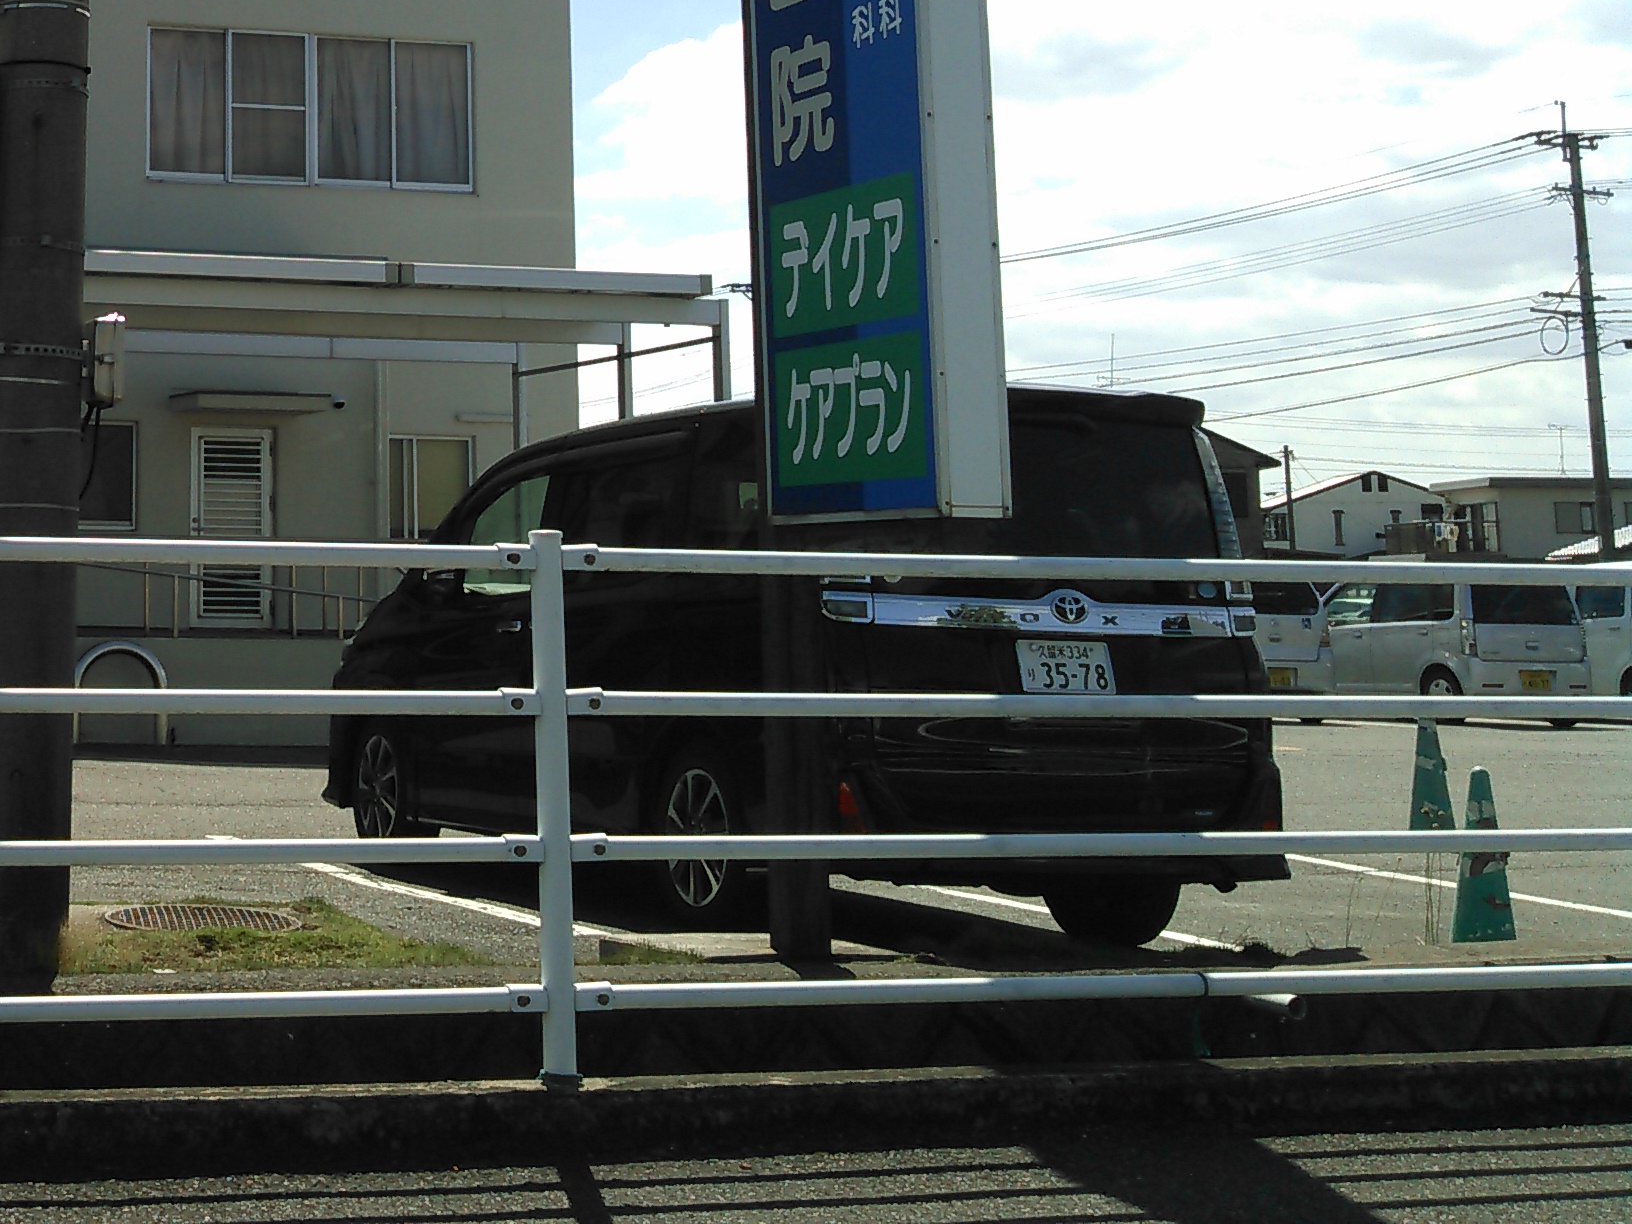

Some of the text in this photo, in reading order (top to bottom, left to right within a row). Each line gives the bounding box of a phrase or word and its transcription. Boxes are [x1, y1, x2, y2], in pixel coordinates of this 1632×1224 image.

[787, 352, 911, 466] ケアプラン
[1040, 662, 1109, 691] 35-78
